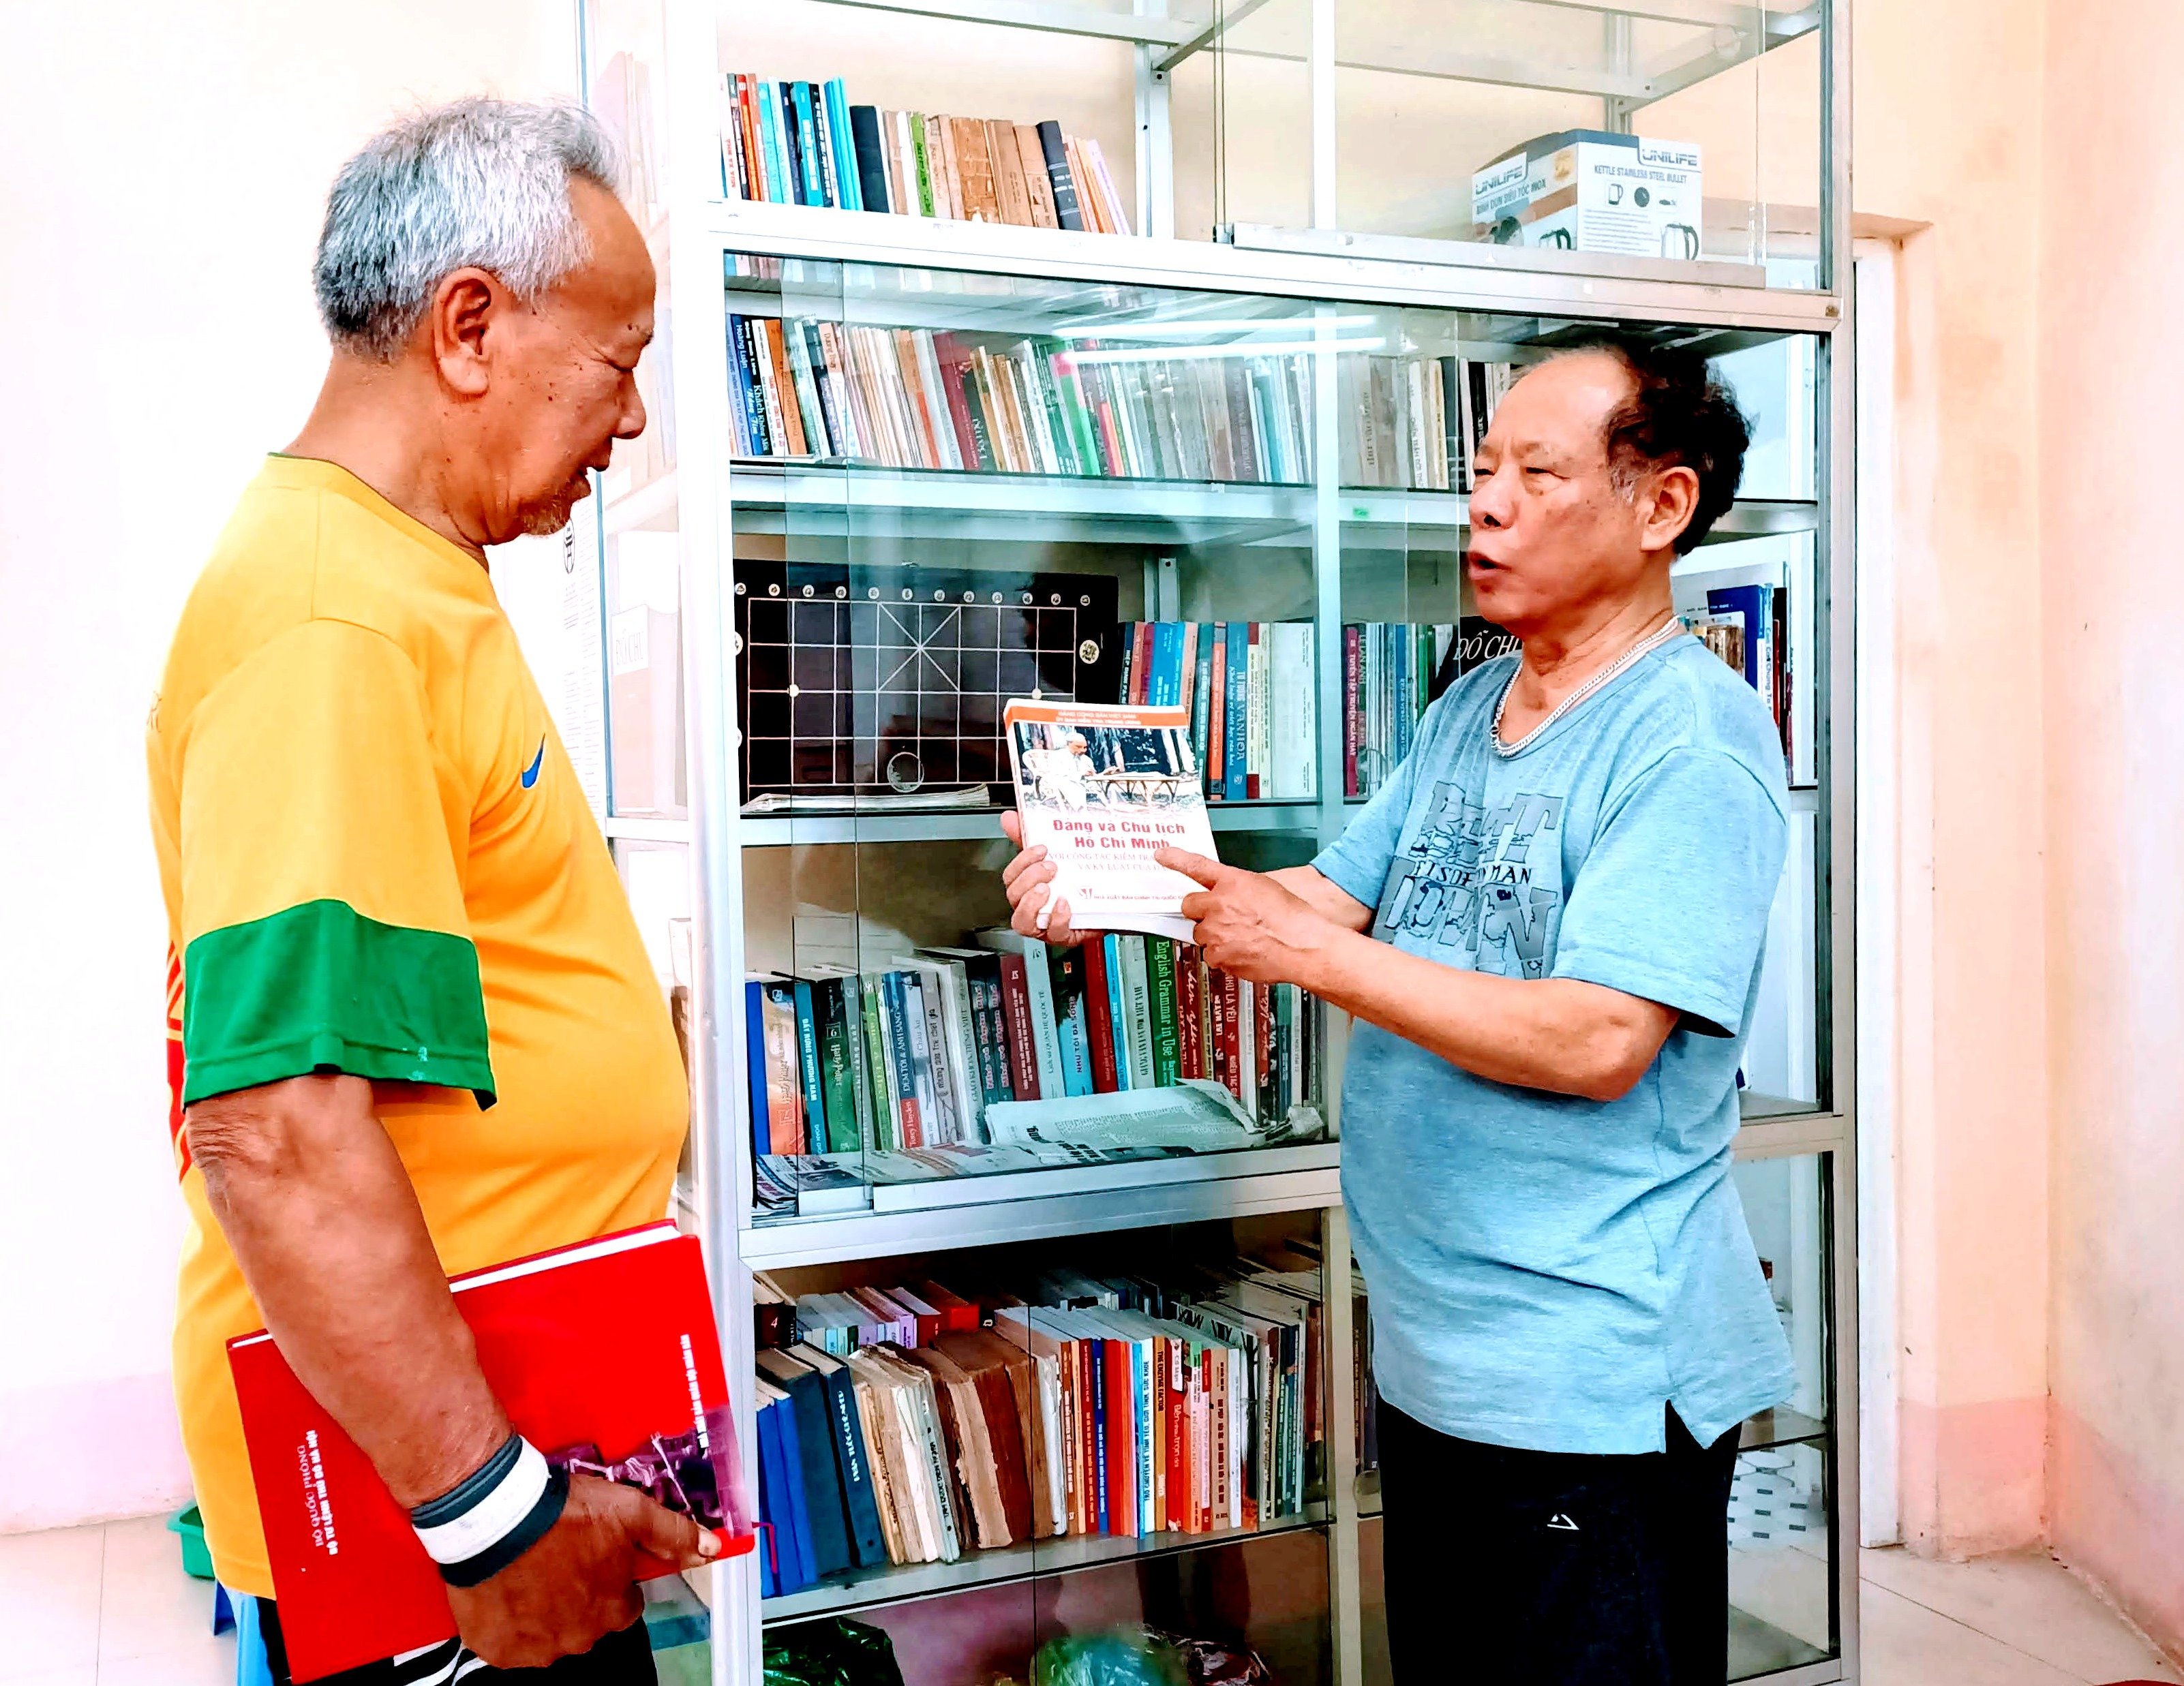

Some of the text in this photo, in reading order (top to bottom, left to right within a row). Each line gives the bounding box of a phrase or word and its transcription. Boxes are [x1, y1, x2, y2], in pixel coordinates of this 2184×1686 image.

[1641, 149, 1697, 166] UNILIFE
[1476, 165, 1522, 195] UNILIFE
[1594, 165, 1687, 183] KETTLE STAINLESS STEEL BULLET
[733, 324, 746, 350] Hoàng
[753, 384, 764, 413] Khách
[1053, 818, 1185, 836] Đảng và Chủ tịch
[1075, 833, 1170, 849] Hồ Chí Minh
[1153, 940, 1175, 1056] English Grammar in Use
[1226, 1005, 1236, 1022] YÊU
[802, 1018, 811, 1031] ĐẤT
[834, 1063, 844, 1085] Potter
[770, 1316, 778, 1328] 4
[295, 1444, 324, 1547] BỘ QUỐC PHÒNG
[305, 1429, 339, 1556] BỘ TƯ LỆNH THỦ ĐÔ HÀ NỘI
